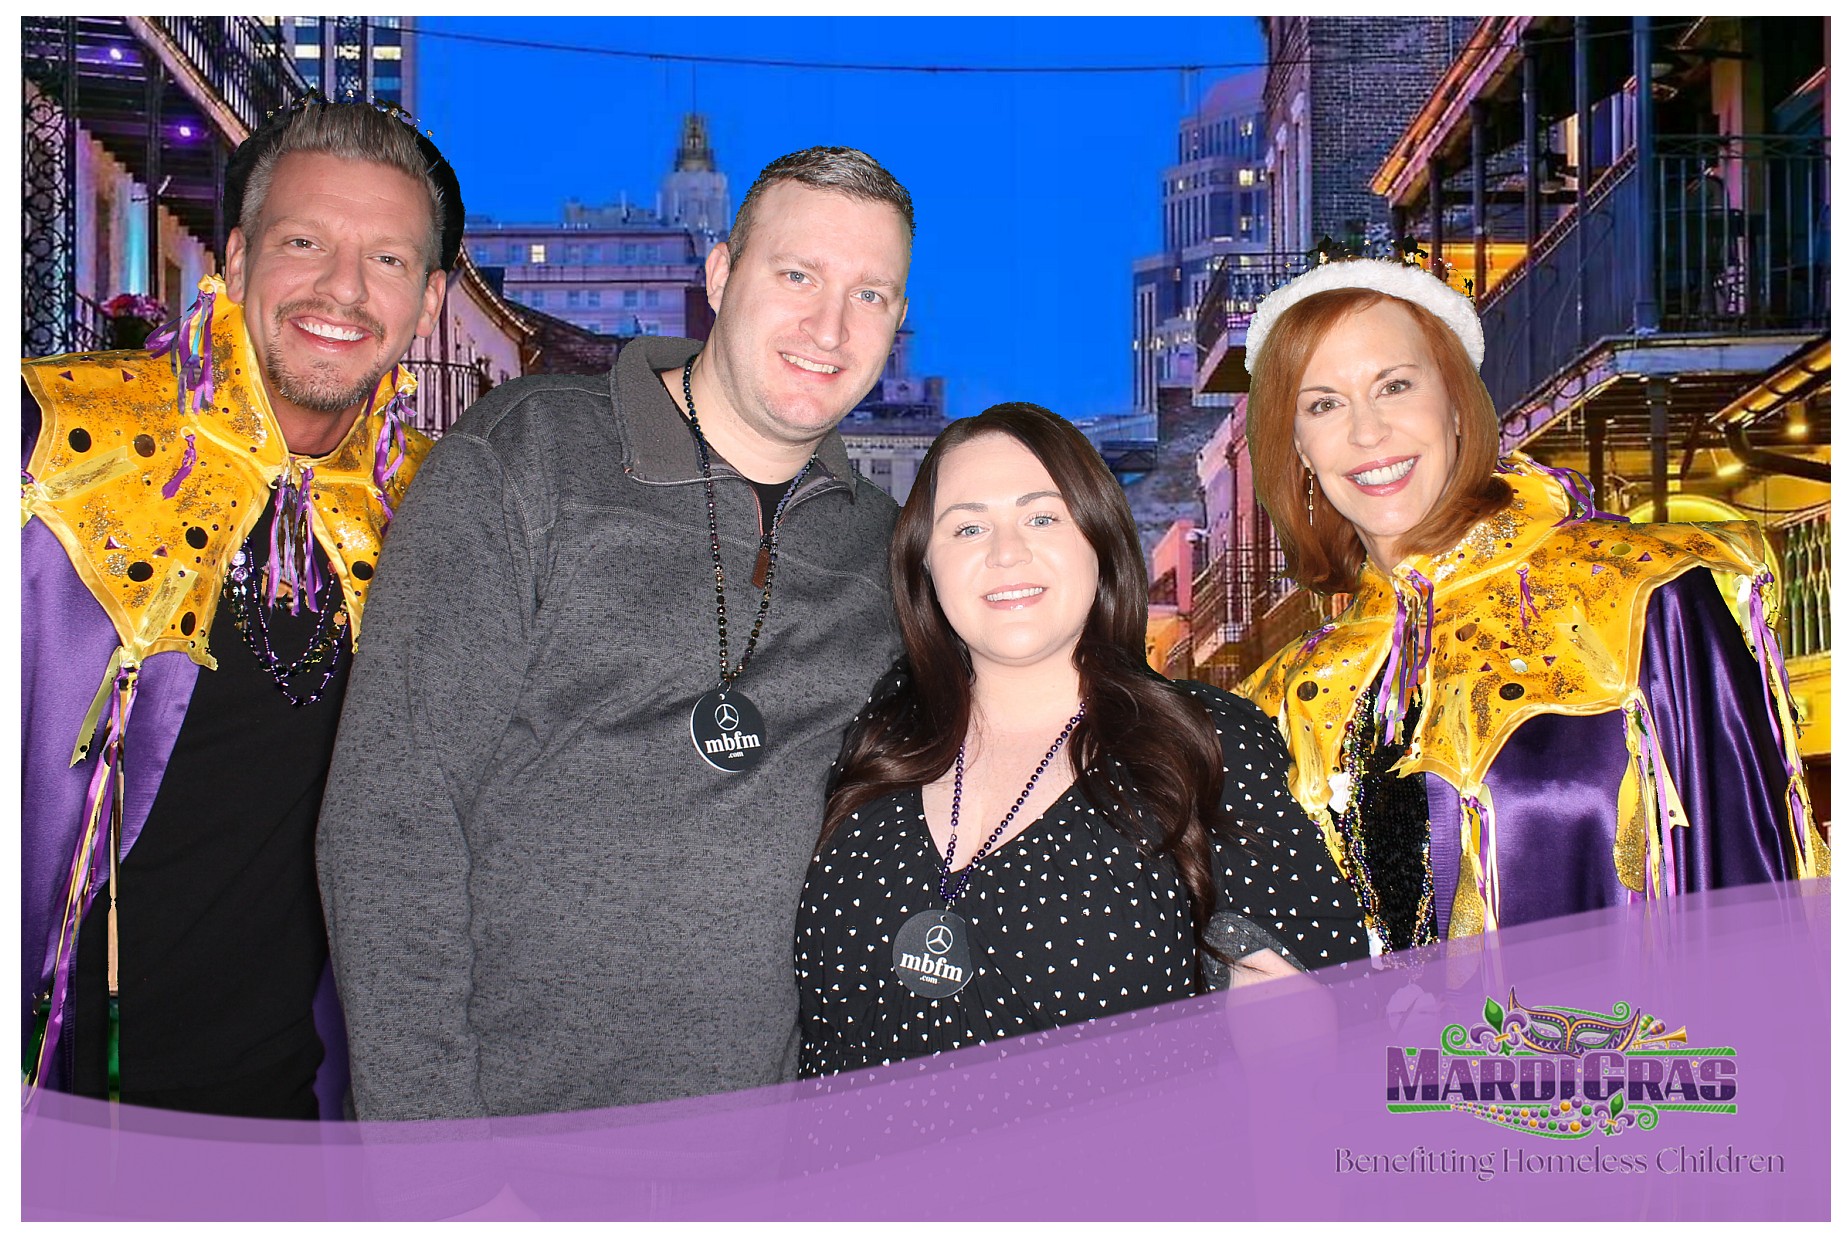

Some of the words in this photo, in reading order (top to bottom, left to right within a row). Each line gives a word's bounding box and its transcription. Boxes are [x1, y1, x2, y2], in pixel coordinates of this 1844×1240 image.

[705, 731, 761, 753] mbfm
[728, 751, 744, 759] .com
[899, 953, 963, 982] mbfm
[919, 975, 938, 985] .com
